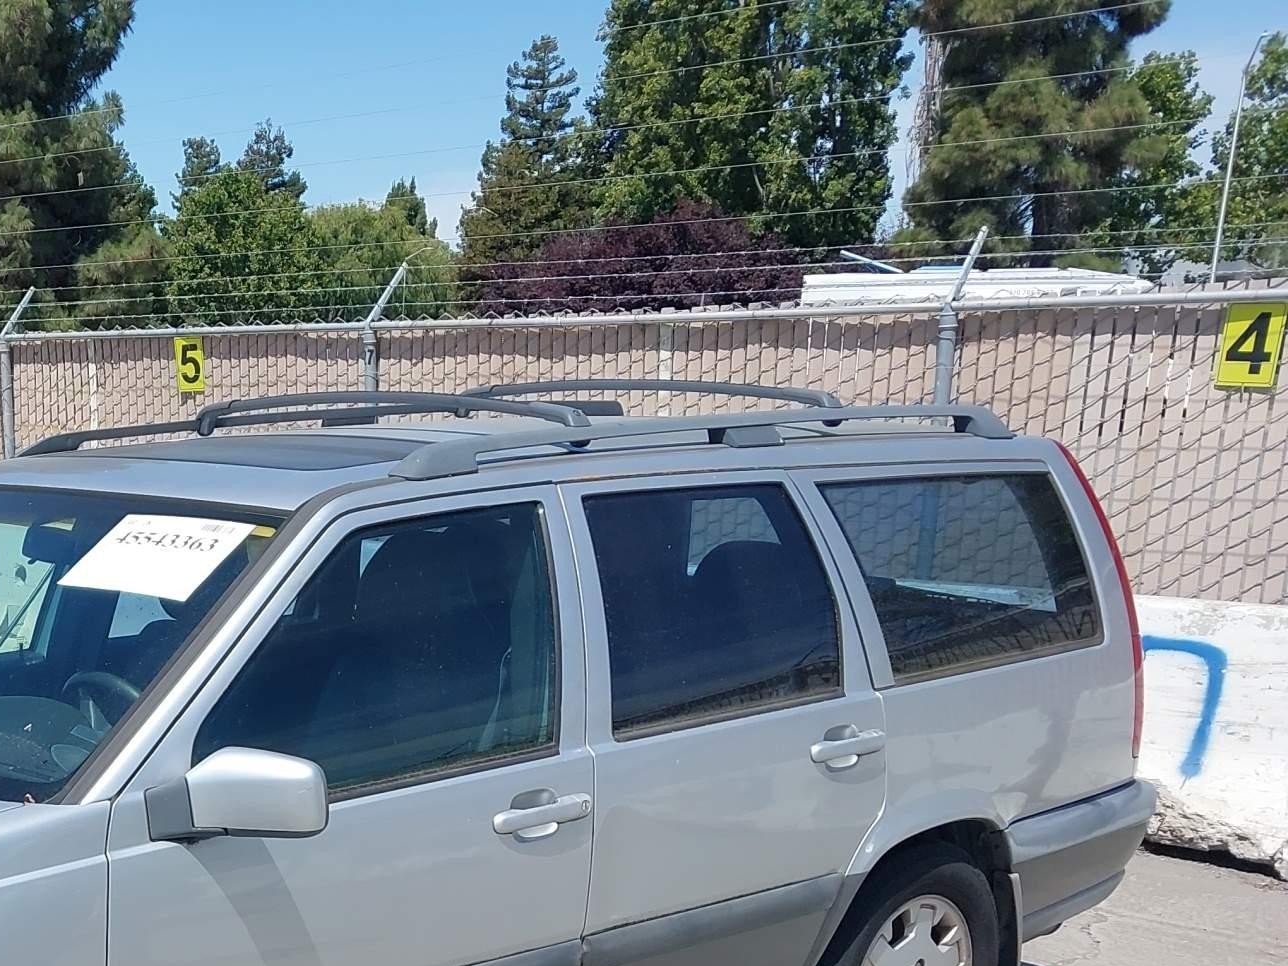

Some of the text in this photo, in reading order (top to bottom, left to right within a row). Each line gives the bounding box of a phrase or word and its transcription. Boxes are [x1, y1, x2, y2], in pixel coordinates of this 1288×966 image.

[367, 348, 374, 365] 7
[1225, 311, 1272, 374] 4
[181, 343, 200, 384] 5
[115, 530, 219, 552] 45543363
